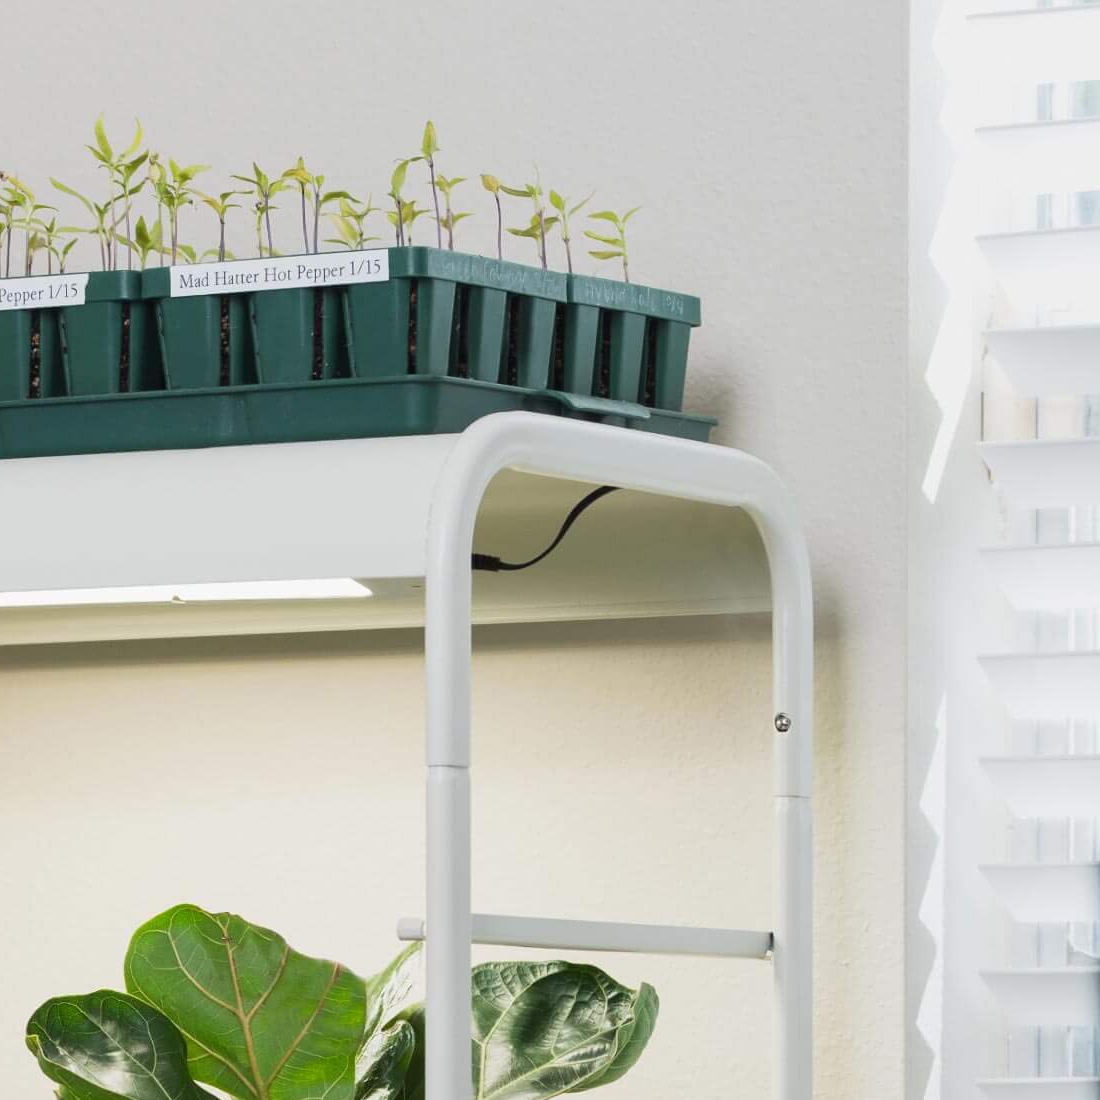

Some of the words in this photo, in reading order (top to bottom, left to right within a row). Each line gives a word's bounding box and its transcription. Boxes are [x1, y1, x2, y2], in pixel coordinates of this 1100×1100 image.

[179, 272, 209, 289] Mad
[214, 269, 260, 286] Hatter
[264, 266, 291, 282] Hot
[297, 264, 346, 283] Pepper
[349, 258, 381, 276] 1/15
[49, 283, 78, 299] 1/15
